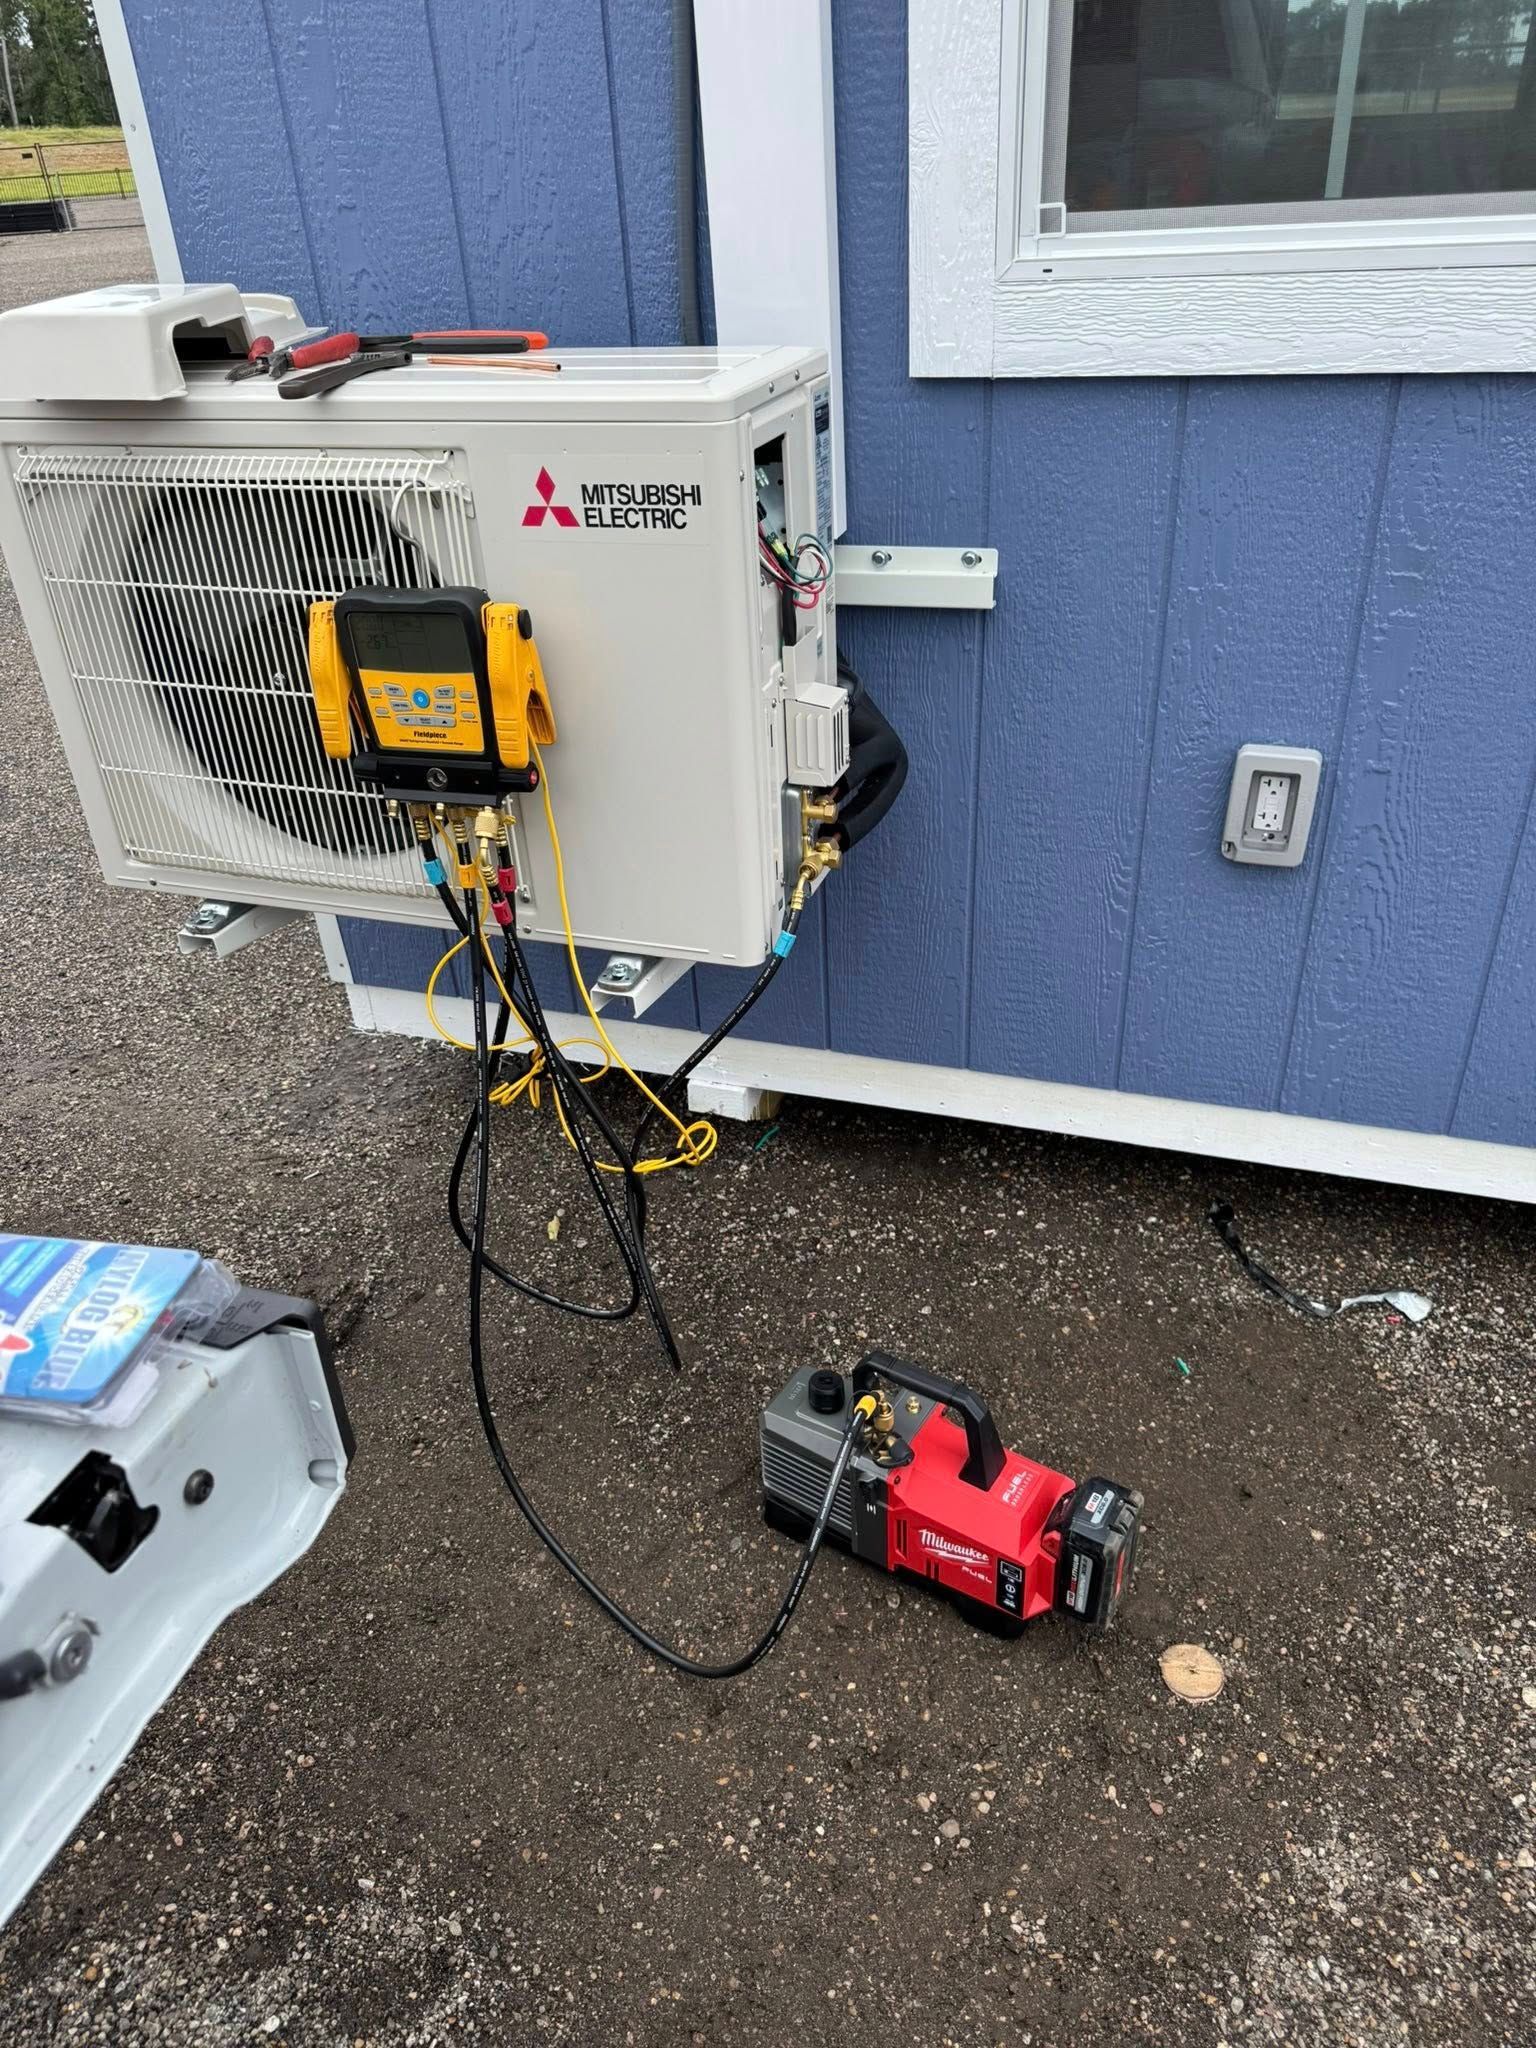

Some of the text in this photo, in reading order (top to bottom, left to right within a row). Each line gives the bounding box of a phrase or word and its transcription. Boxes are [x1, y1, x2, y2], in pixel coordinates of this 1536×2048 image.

[581, 484, 701, 506] MITSUBISHI
[584, 507, 687, 529] ELECTRIC
[413, 730, 447, 739] Fieldpiece
[31, 1327, 97, 1390] BLUE
[1002, 1471, 1027, 1504] FUEL
[919, 1528, 989, 1562] Milwaukee
[961, 1565, 993, 1584] FUEL
